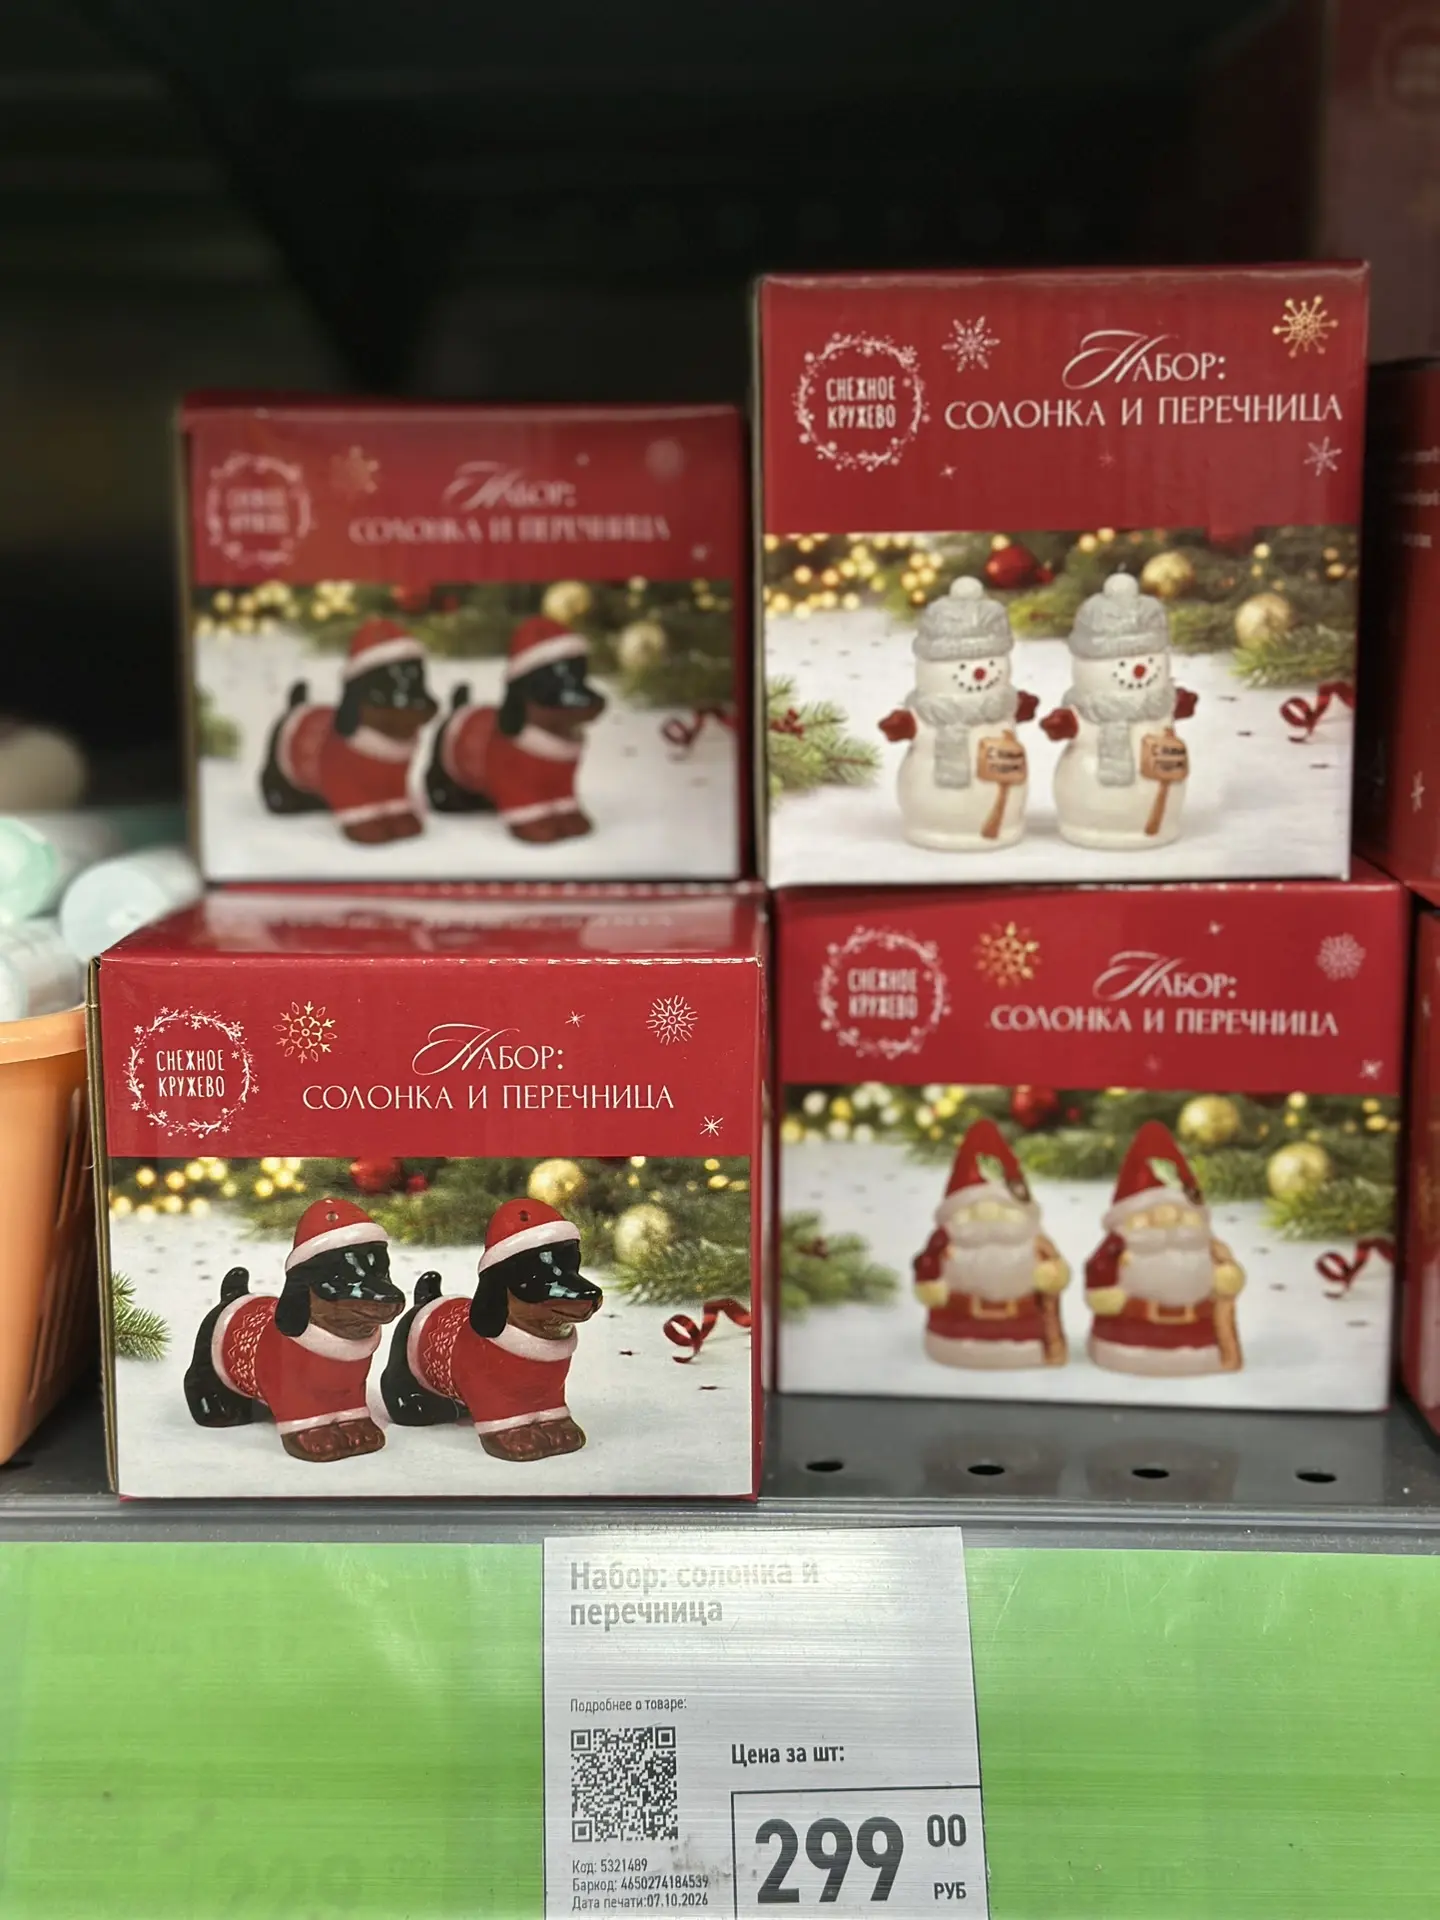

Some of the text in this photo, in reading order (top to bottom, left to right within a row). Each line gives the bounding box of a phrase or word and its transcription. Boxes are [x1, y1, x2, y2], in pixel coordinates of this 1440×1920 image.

[1062, 330, 1227, 389] НАБОР:
[826, 377, 896, 402] СНЕЖНОЕ
[827, 404, 896, 429] КРУЖЕВО
[944, 394, 1343, 430] СОЛОНКА И ПЕРЕЧНИЦА
[1093, 950, 1237, 1001] НАБОР:
[990, 1005, 1339, 1037] СОЛОНКА И ПЕРЕЧНИЦА
[156, 1049, 225, 1073] СНЕЖНОЕ
[411, 1022, 564, 1076] НАБОР:
[158, 1075, 226, 1099] КРУЖЕВО
[302, 1084, 675, 1110] СОЛОНКА И ПЕРЕЧНИЦА
[570, 1561, 820, 1593] Набор: солонка и
[570, 1601, 723, 1631] перечница
[570, 1697, 687, 1714] Подробнее о товаре:
[731, 1743, 845, 1767] Цена за шт:
[927, 1814, 967, 1848] 00
[572, 1857, 648, 1876] Код: 5321489
[753, 1816, 904, 1904] 299
[572, 1874, 709, 1893] Баркод: 4650274184539
[933, 1881, 967, 1900] РУБ
[572, 1895, 600, 1911] Дата
